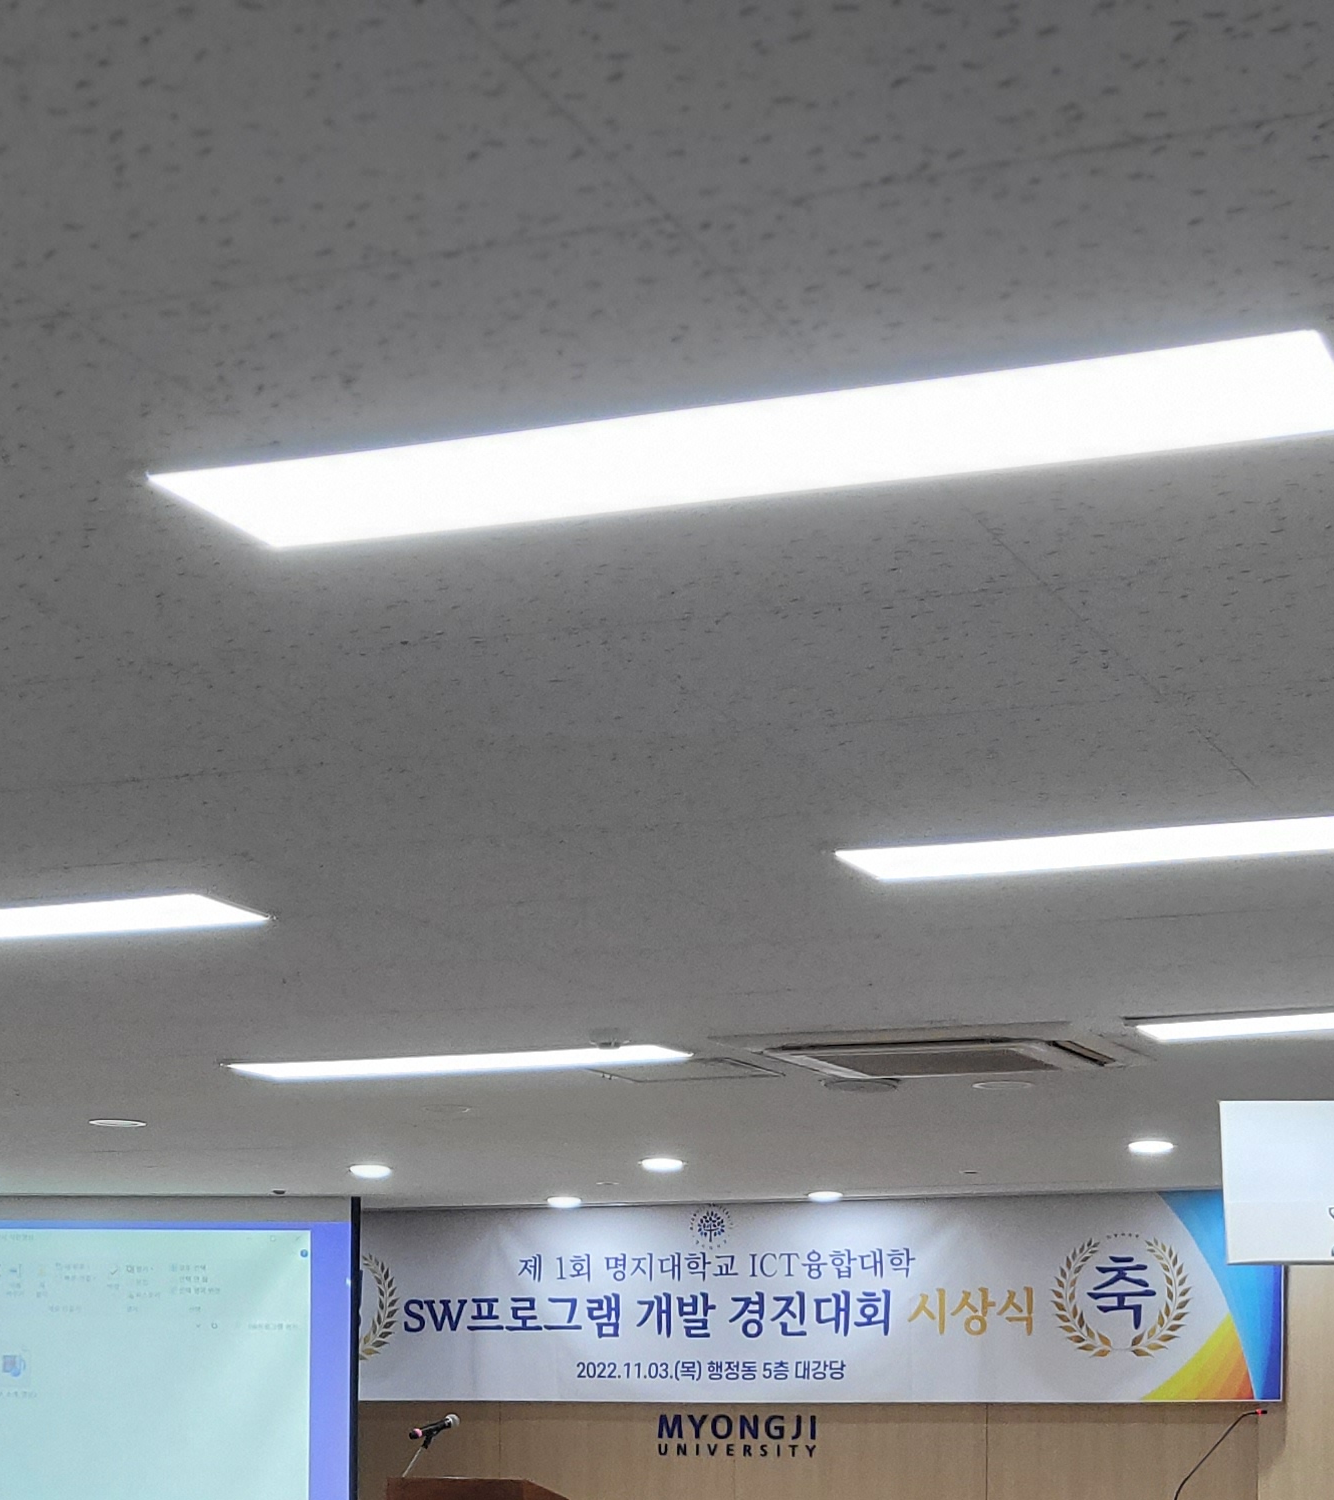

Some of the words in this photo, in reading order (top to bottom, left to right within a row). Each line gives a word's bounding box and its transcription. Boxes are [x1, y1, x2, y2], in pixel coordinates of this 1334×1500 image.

[517, 1253, 542, 1283] 제
[556, 1253, 592, 1283] 1회
[604, 1251, 739, 1283] 명지대학교
[749, 1248, 916, 1280] ICT융합대학
[1086, 1255, 1157, 1330] 축
[403, 1292, 622, 1339] SW프로그램
[636, 1291, 717, 1339] 개발
[728, 1289, 892, 1339] 경진대회
[907, 1284, 1035, 1337] 시상식
[576, 1360, 702, 1382] 2022.11.03.(목)
[707, 1360, 758, 1381] 행정동
[762, 1360, 790, 1381] 5층
[794, 1360, 847, 1381] 대강당
[657, 1414, 817, 1440] MYONGJI
[657, 1443, 817, 1458] UNIVERSITY
